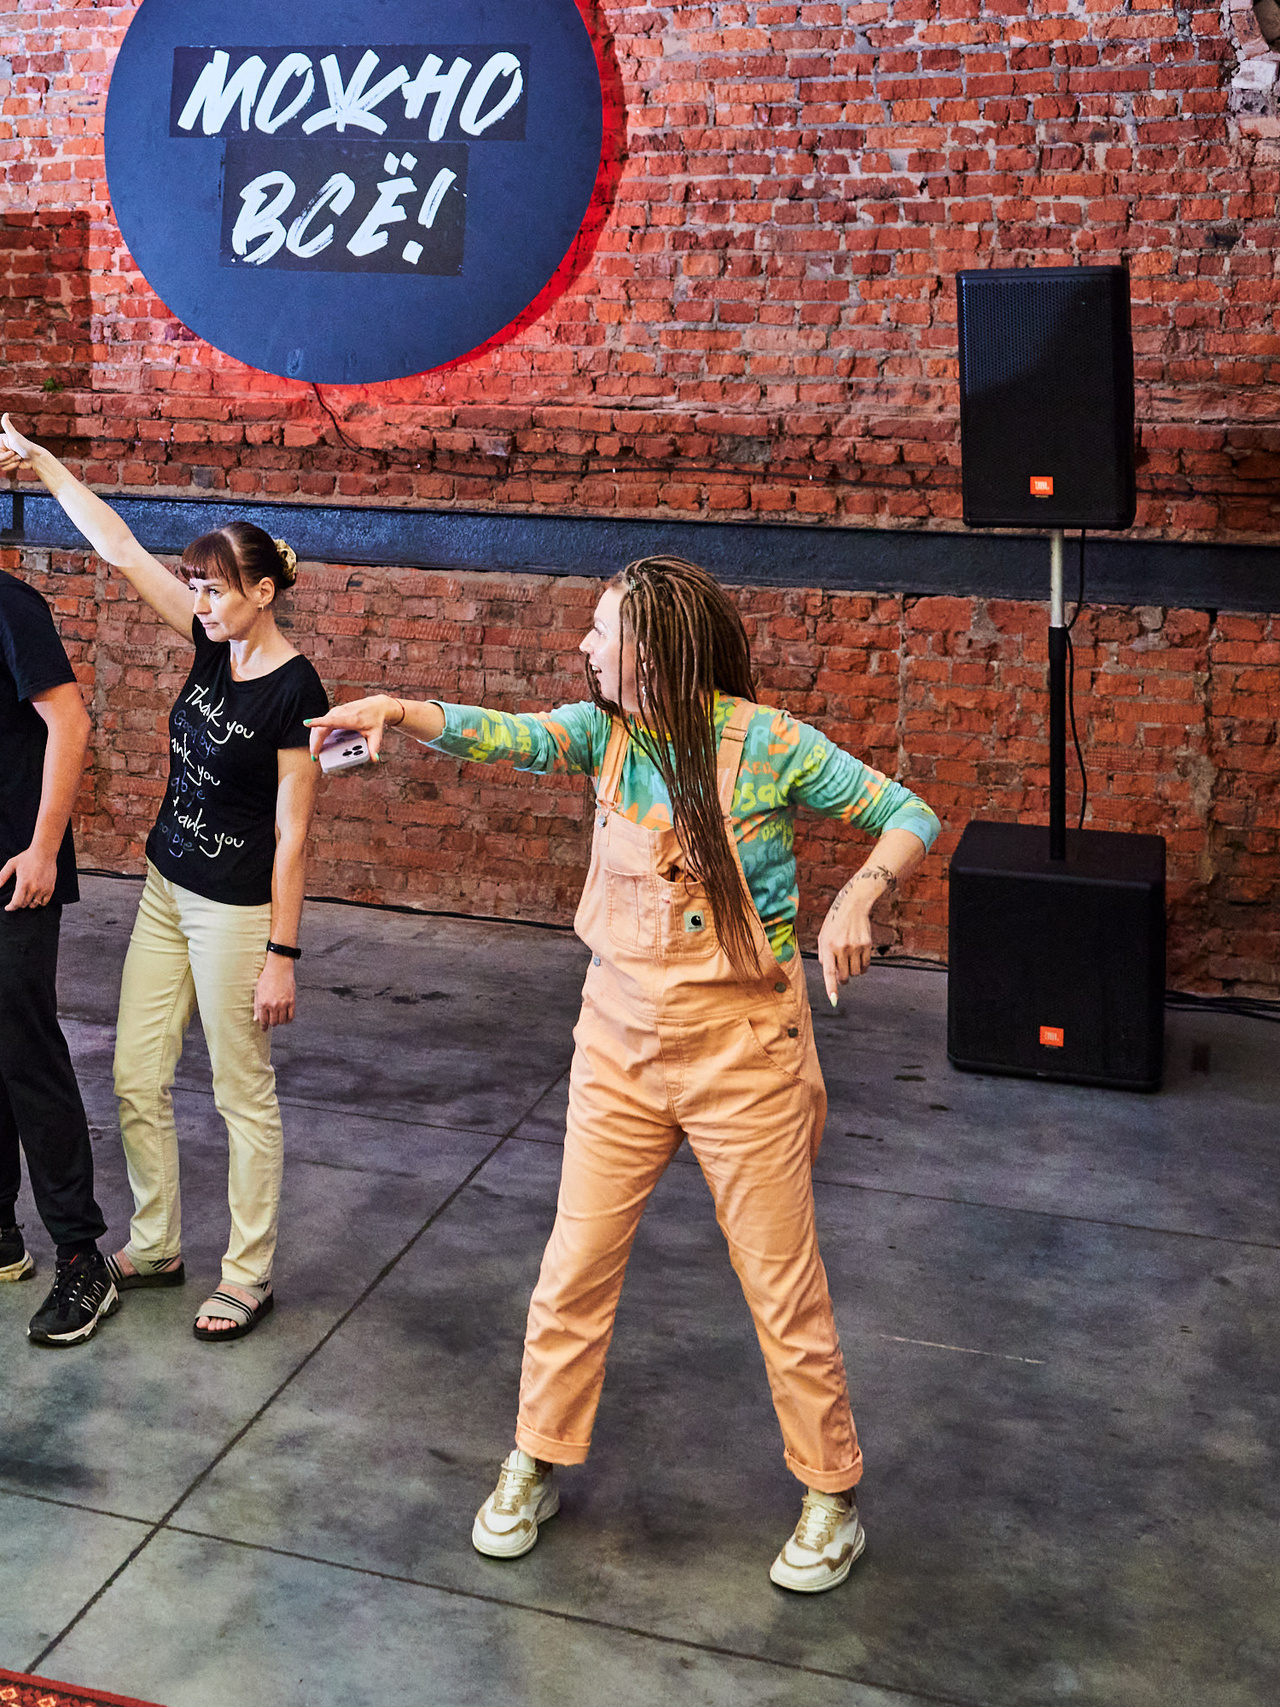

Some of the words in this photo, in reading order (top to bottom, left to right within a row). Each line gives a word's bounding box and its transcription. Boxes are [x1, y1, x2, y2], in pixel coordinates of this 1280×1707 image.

[177, 49, 524, 142] МОЖНО
[231, 152, 458, 265] ВСЁ!
[185, 684, 225, 728] Thank
[207, 720, 255, 745] you
